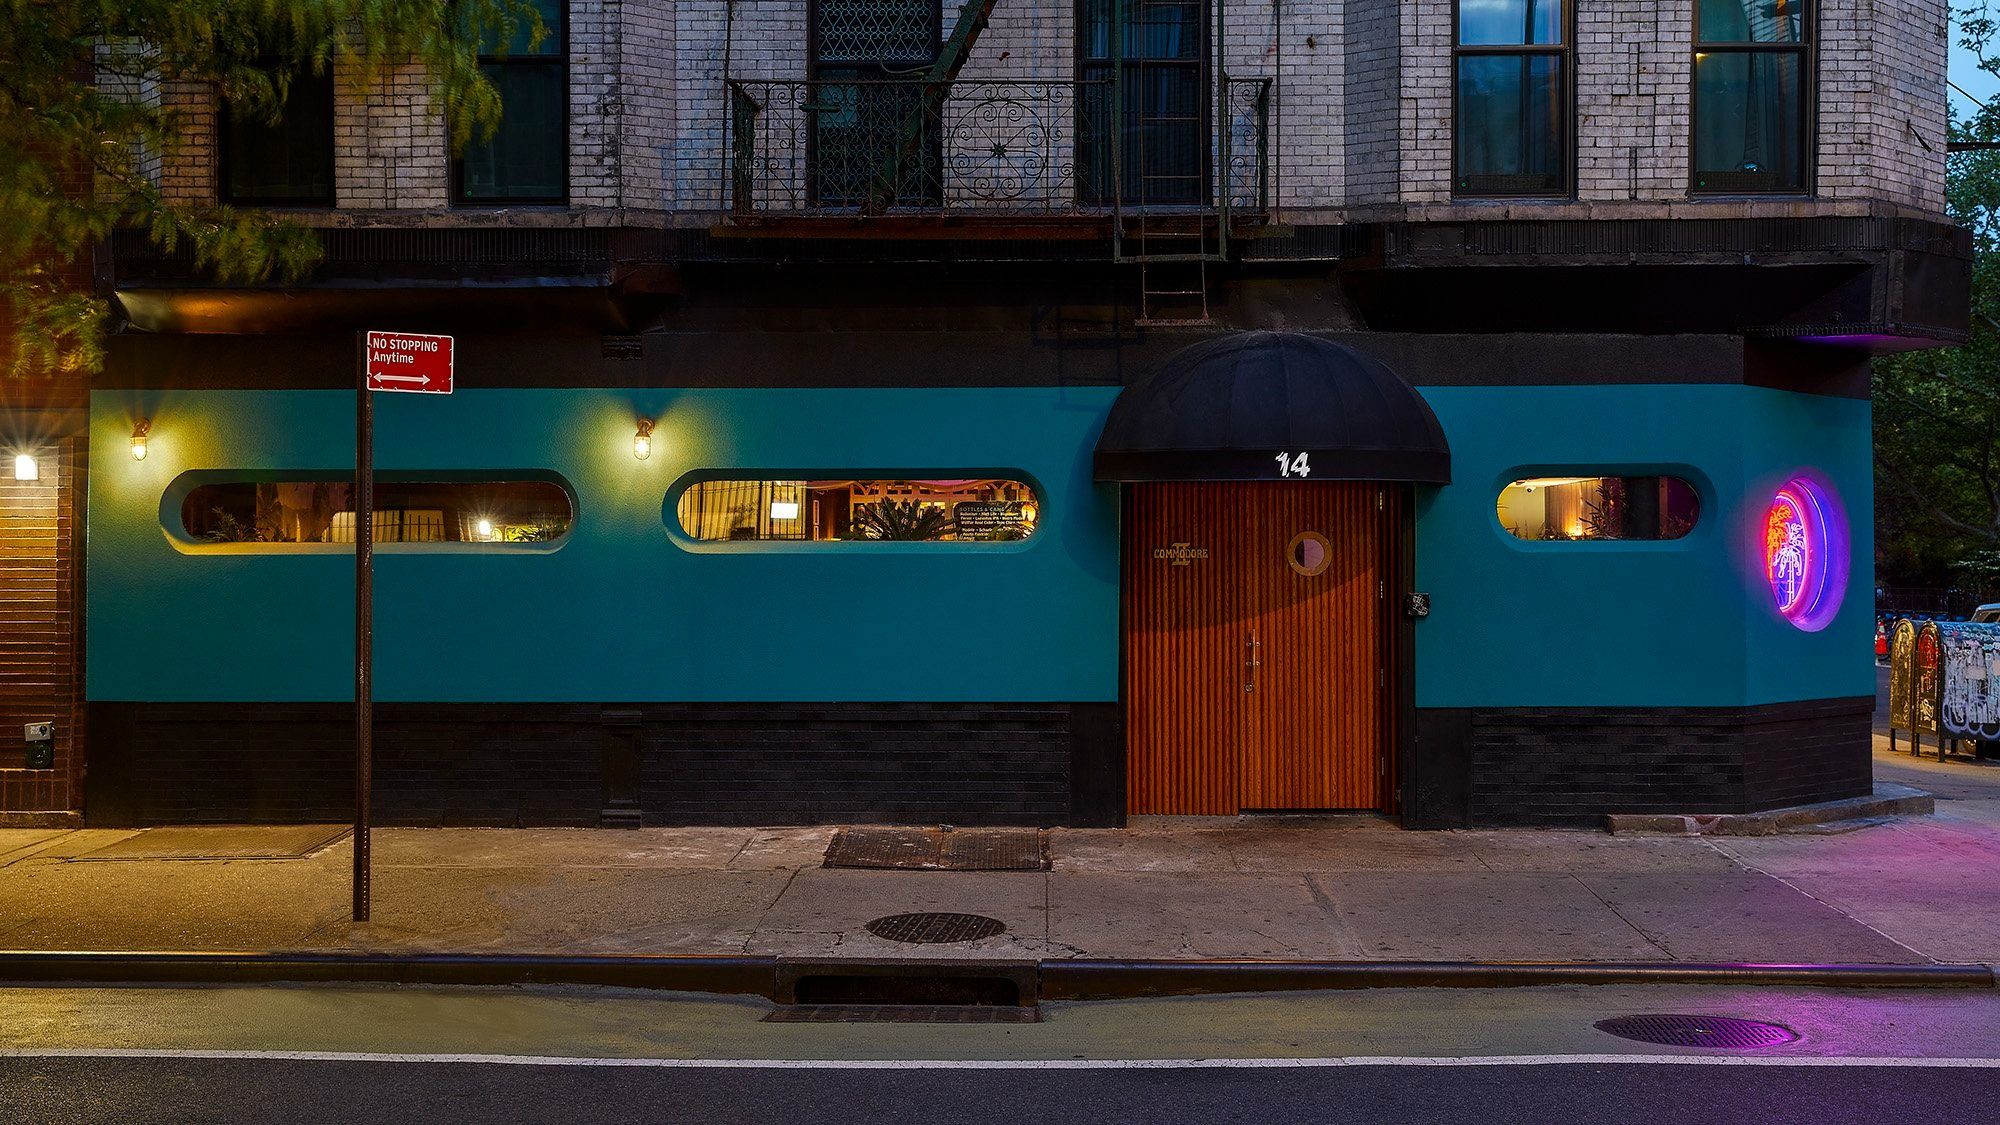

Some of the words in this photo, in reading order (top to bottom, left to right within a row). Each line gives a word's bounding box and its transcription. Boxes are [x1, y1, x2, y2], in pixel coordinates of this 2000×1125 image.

[373, 338, 387, 349] NO
[389, 339, 438, 352] STOPPING
[373, 351, 414, 364] Anytime
[1275, 451, 1310, 477] 14
[1153, 549, 1209, 559] COMMODORE
